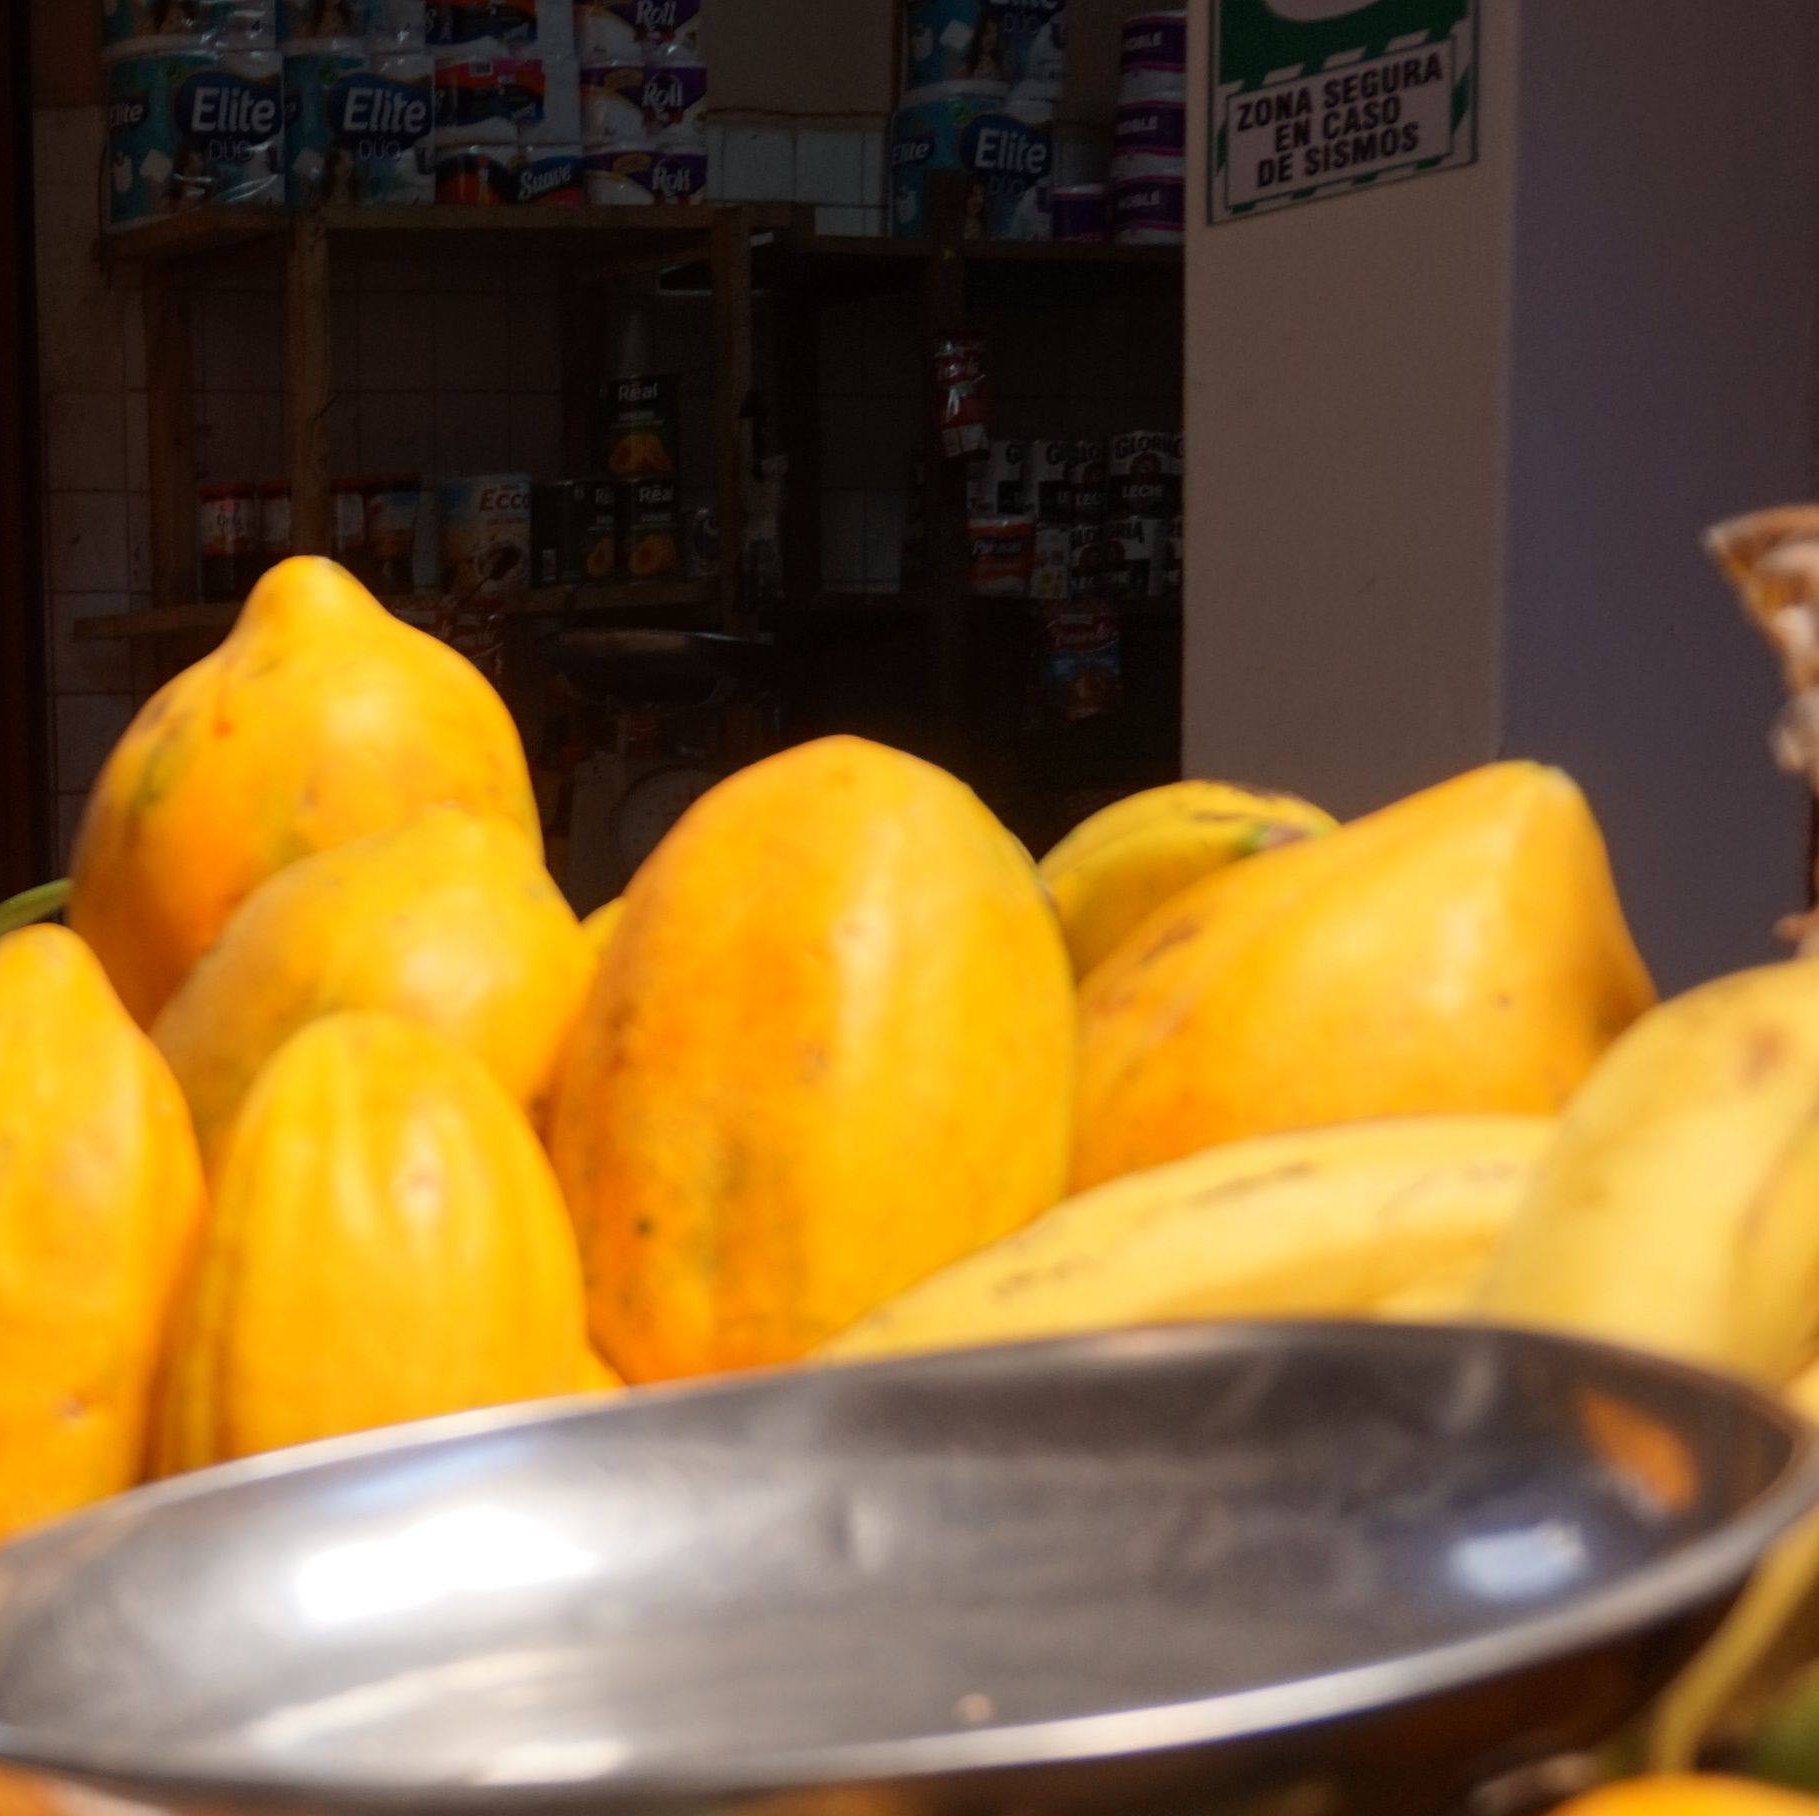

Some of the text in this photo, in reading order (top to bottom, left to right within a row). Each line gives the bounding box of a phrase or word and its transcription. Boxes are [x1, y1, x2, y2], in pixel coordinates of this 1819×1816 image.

[190, 86, 277, 134] Elite
[343, 86, 426, 135] Elite
[1236, 52, 1444, 133] ZONA SEGURA
[1275, 95, 1402, 153] EN CASO
[974, 127, 1048, 175] Elite
[1257, 122, 1420, 189] DE SISMOS
